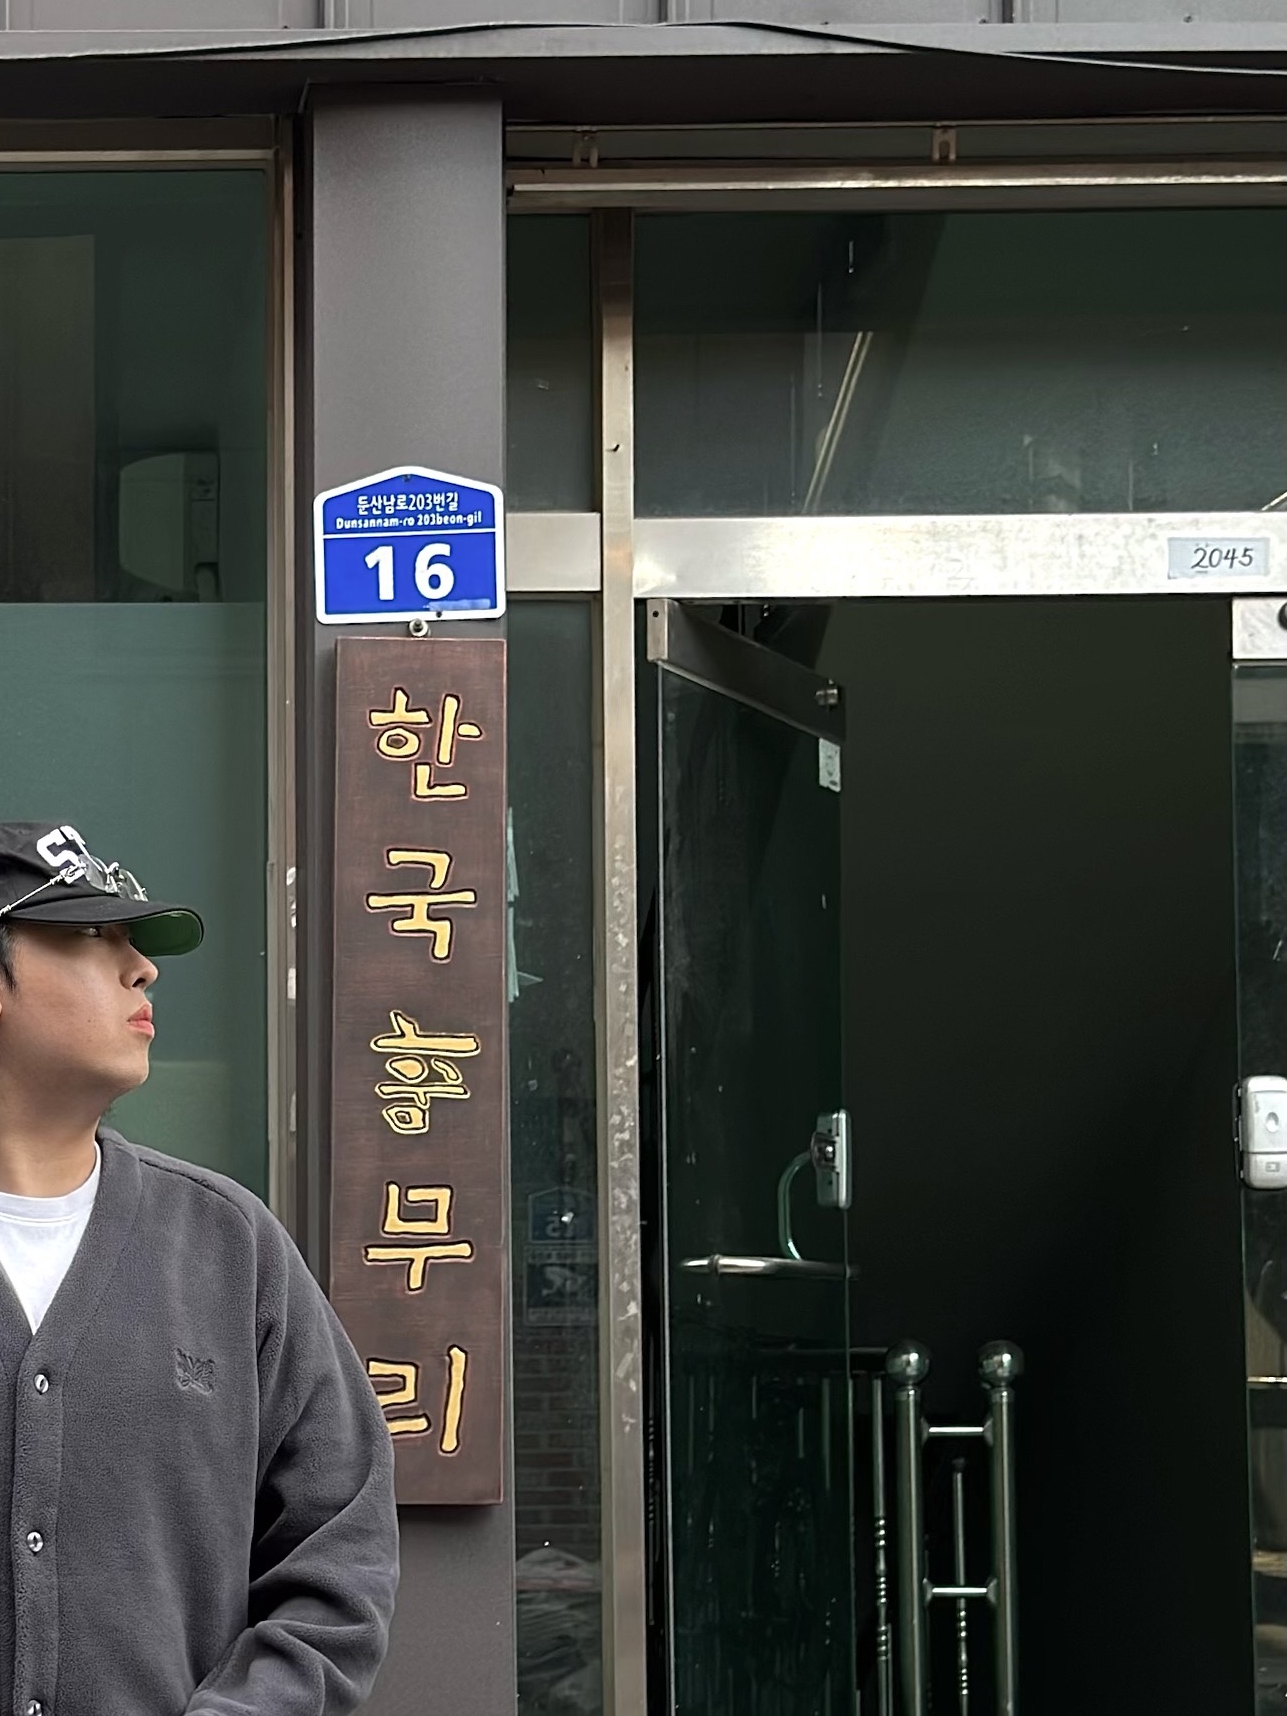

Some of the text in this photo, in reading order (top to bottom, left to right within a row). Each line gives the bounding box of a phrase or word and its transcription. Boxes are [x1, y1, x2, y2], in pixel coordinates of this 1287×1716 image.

[357, 492, 459, 515] 둔산남로203번길
[336, 511, 483, 530] Dunsannam-ro 203beon-gil
[1191, 546, 1254, 570] 2045
[364, 542, 455, 601] 16
